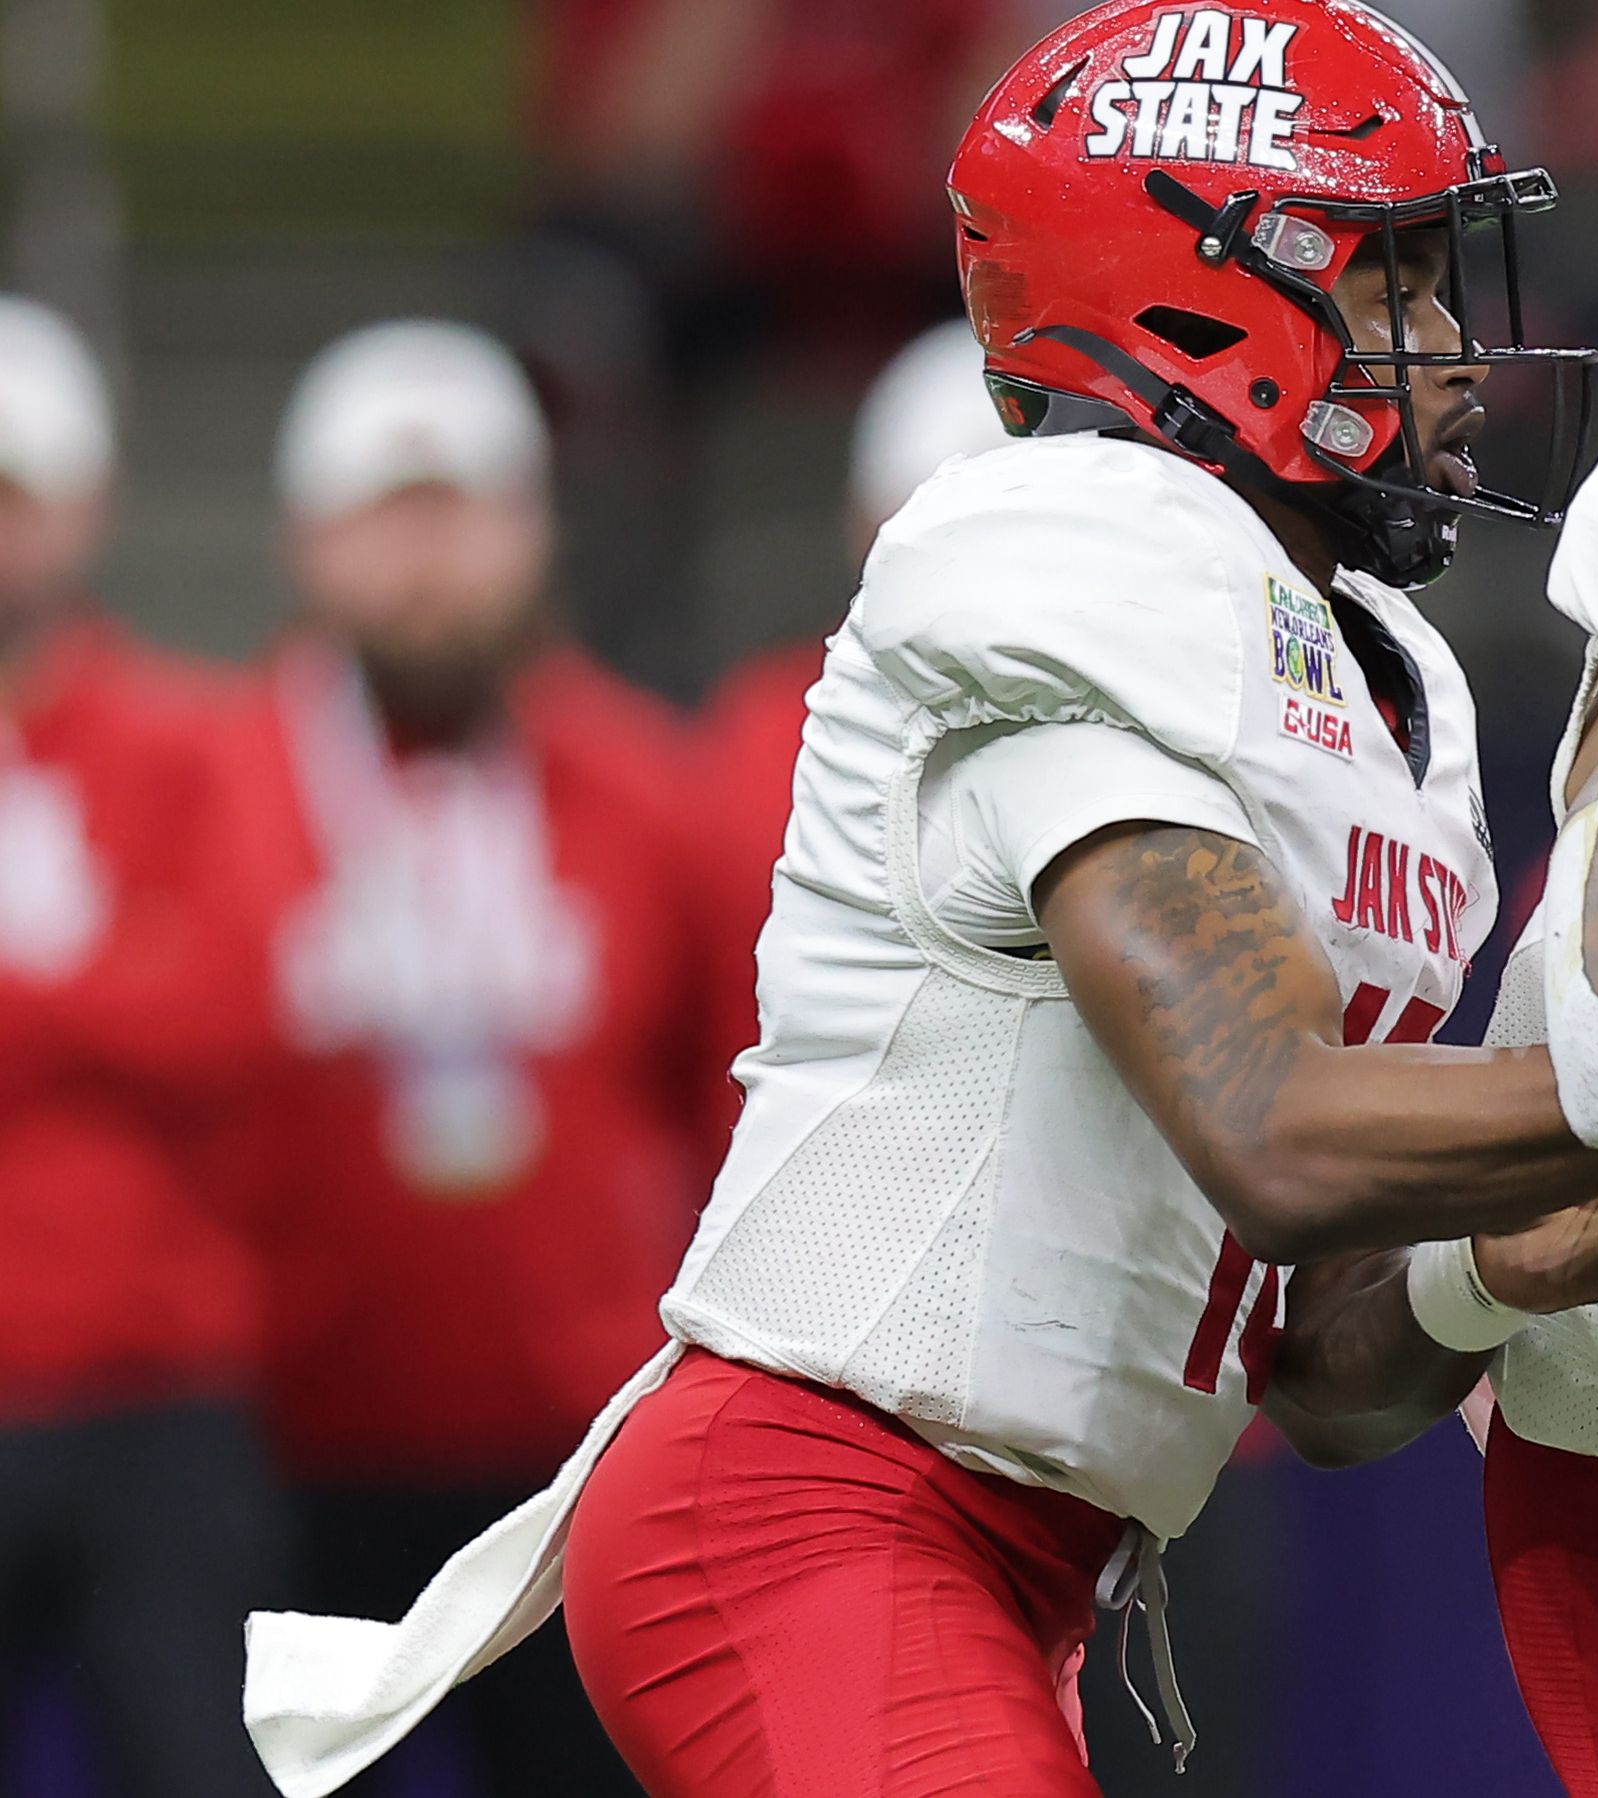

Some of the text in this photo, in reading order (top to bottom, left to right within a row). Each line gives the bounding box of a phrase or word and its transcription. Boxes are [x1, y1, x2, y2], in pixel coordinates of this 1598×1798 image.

[1122, 9, 1298, 88] JAX
[1086, 80, 1304, 171] STATE
[1272, 629, 1344, 701] BOWL
[1291, 615, 1335, 653] ORLEANS
[1331, 823, 1414, 944] JAX
